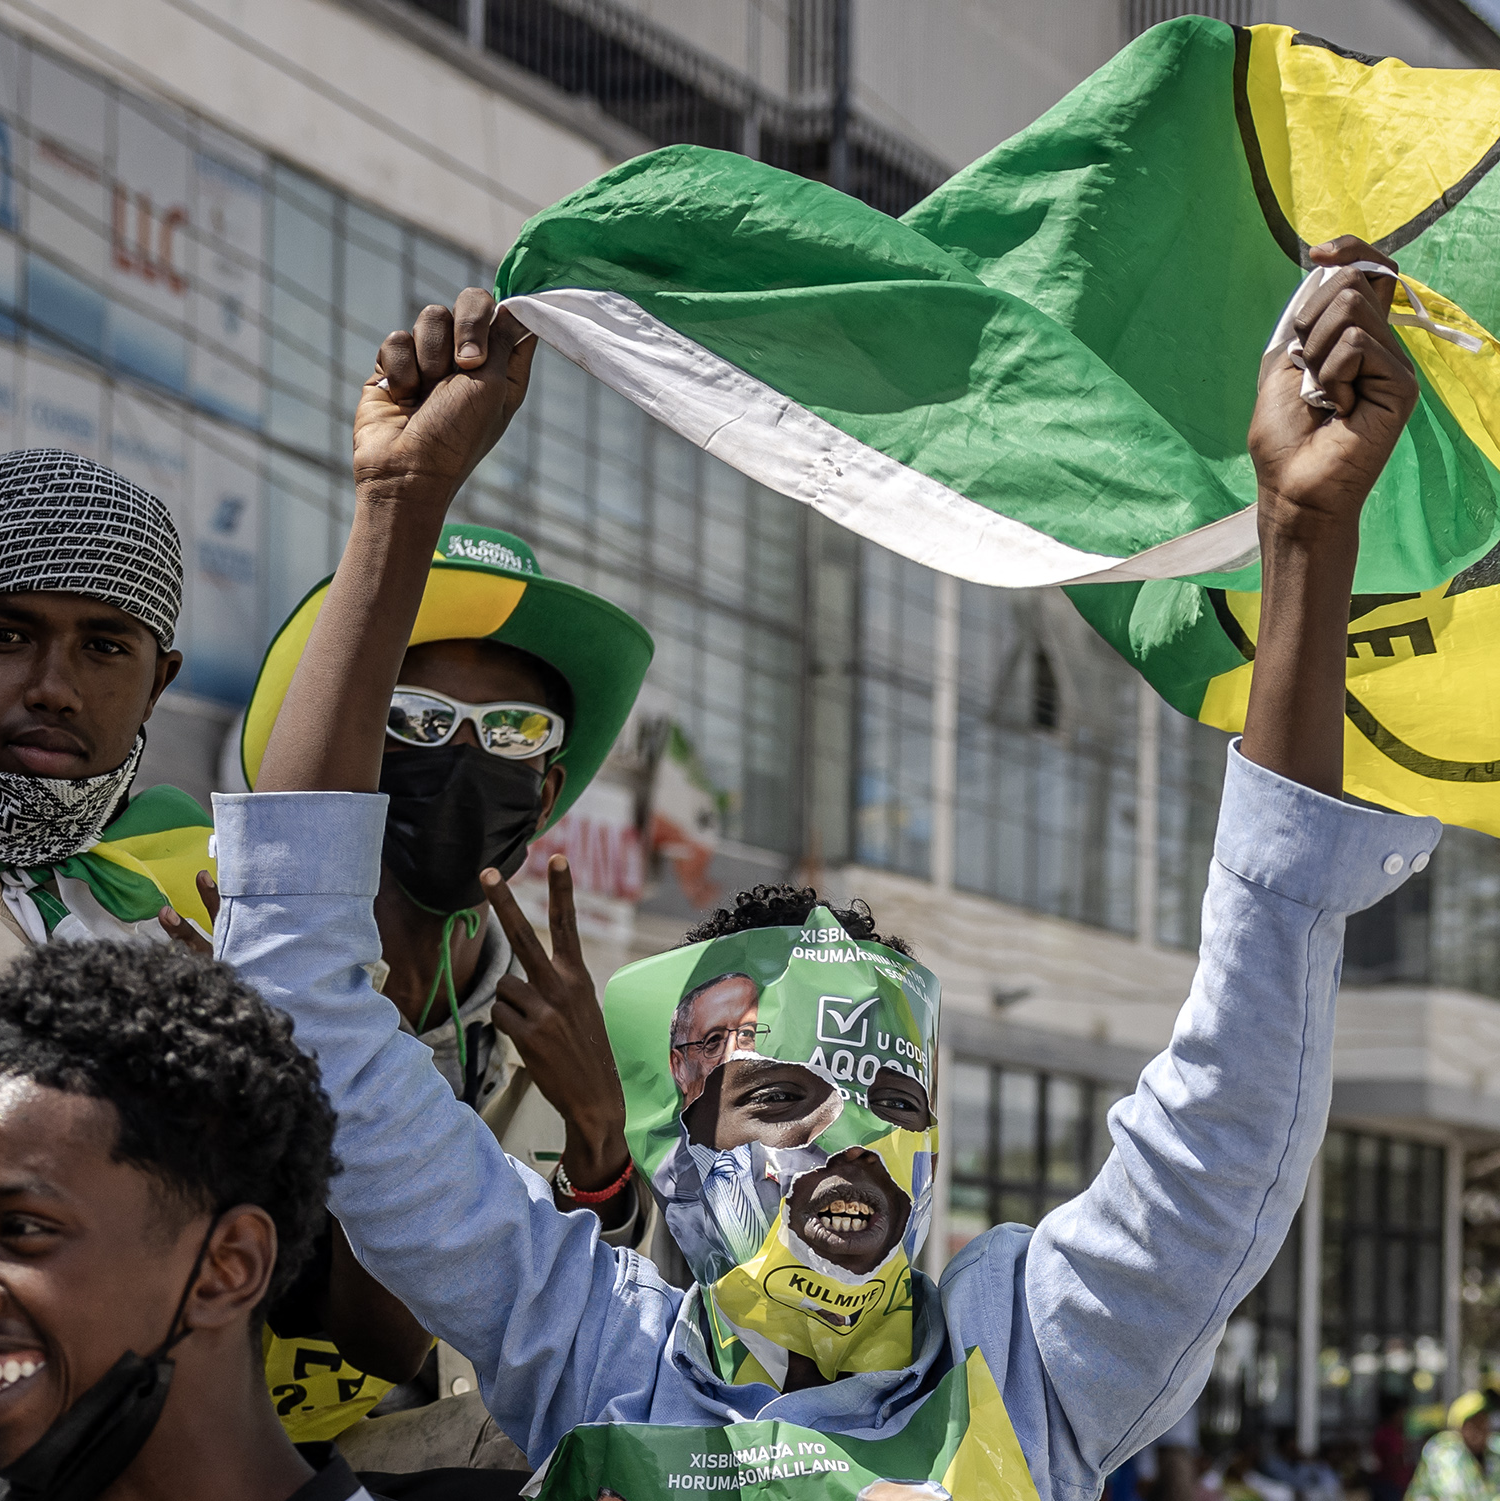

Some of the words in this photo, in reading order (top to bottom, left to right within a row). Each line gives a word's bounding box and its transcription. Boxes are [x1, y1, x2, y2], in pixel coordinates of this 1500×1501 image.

[788, 1273, 879, 1307] KULMIYE
[798, 1442, 826, 1455] IYO
[739, 1459, 850, 1487] SOMALILAND
